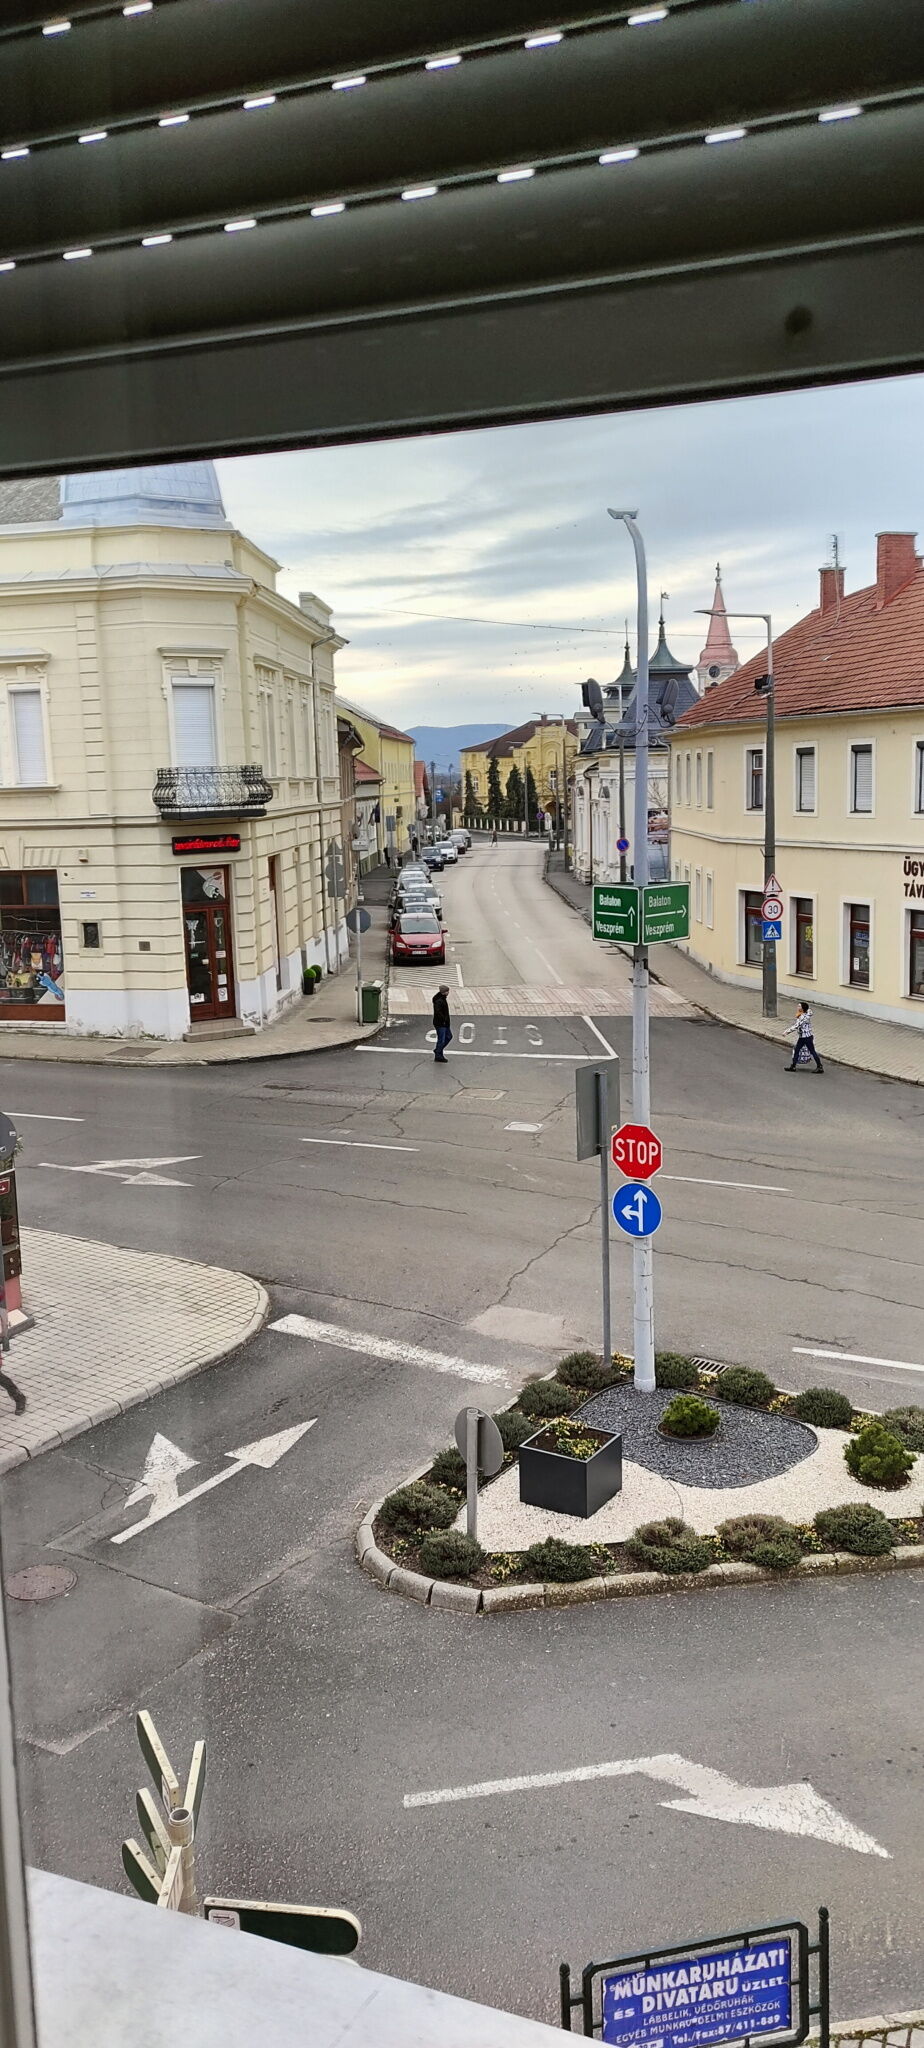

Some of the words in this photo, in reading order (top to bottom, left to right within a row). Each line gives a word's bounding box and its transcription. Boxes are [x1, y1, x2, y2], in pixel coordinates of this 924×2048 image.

[599, 894, 621, 907] Balaton
[648, 896, 672, 908] Balaton
[767, 905, 778, 914] 30
[595, 921, 624, 936] Veszprém
[645, 921, 674, 937] Veszprém
[615, 1137, 659, 1165] STOP
[614, 1949, 785, 2001] MUNKARUHÁZATI
[613, 2008, 635, 2020] ÉS
[642, 1977, 739, 2013] DIVATÁRU
[741, 1976, 784, 1992] ÜZLET
[616, 2029, 647, 2044] EGYÉB
